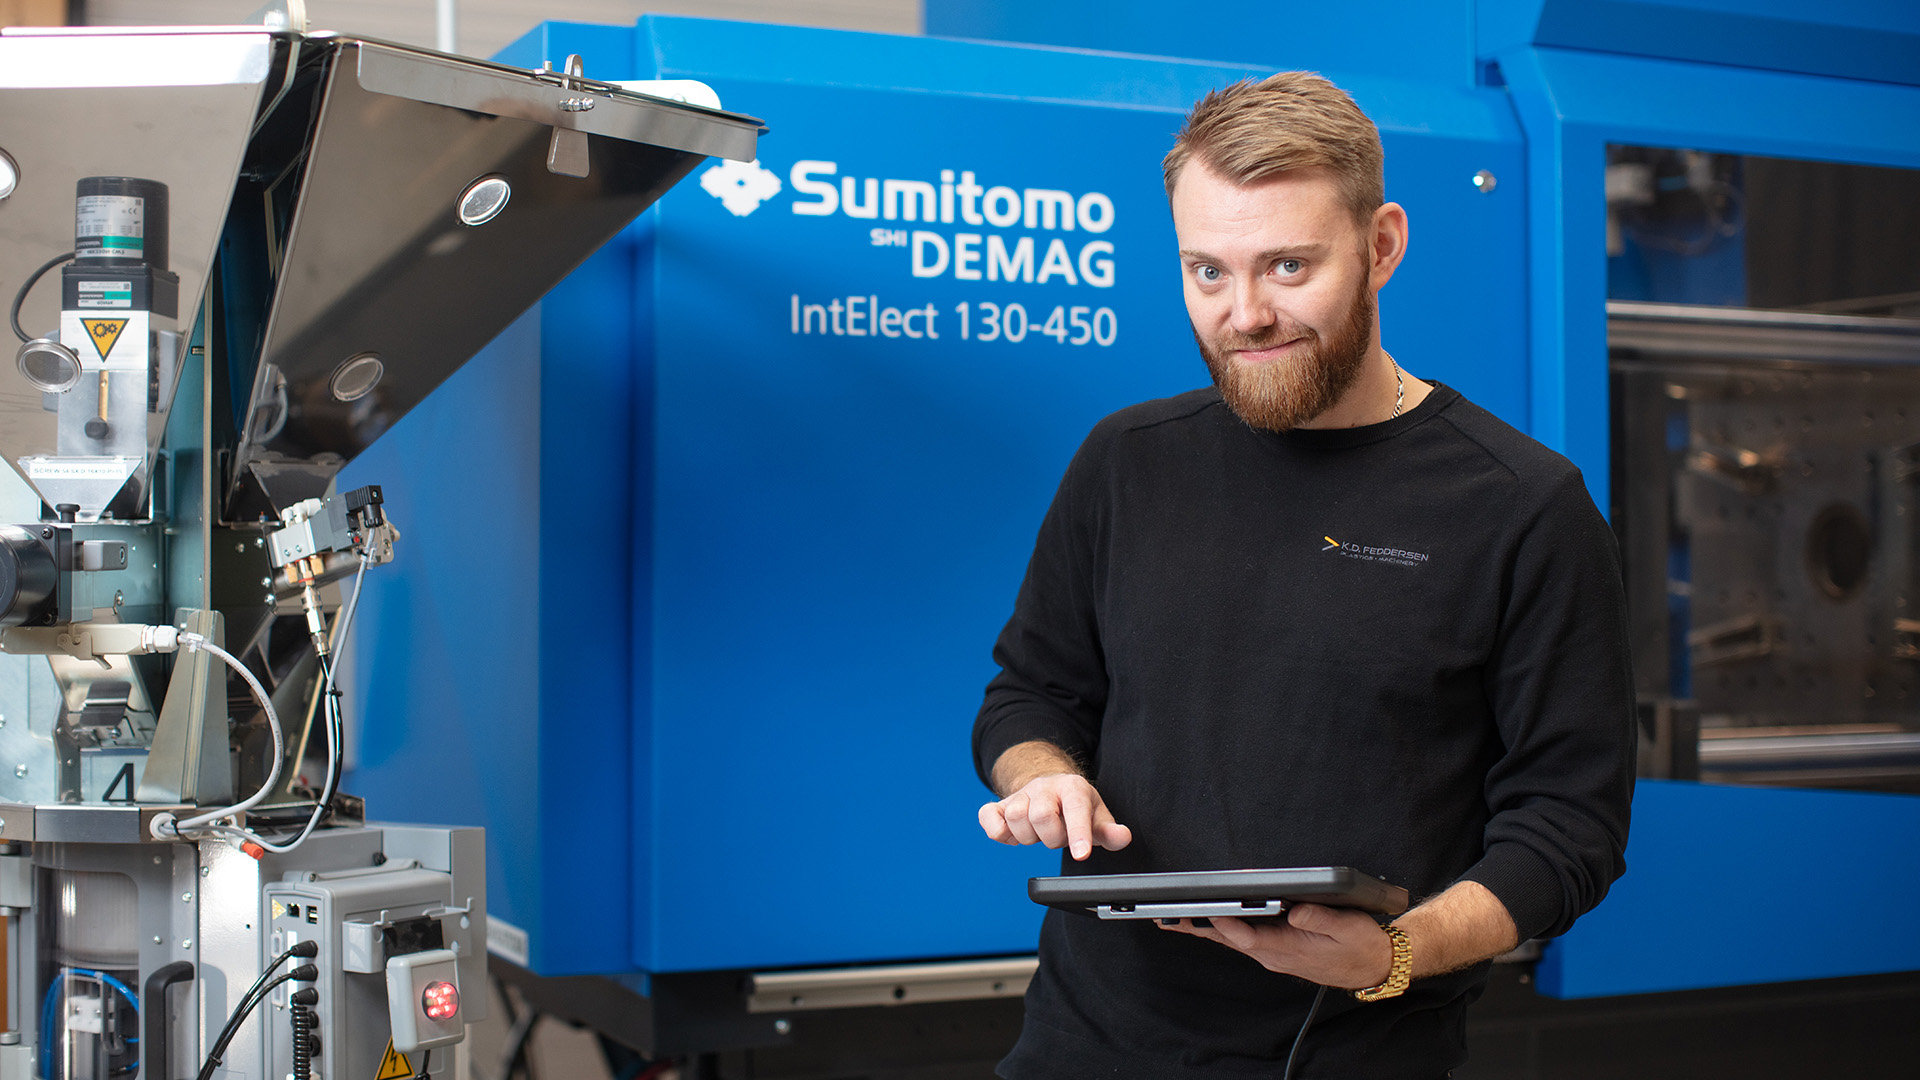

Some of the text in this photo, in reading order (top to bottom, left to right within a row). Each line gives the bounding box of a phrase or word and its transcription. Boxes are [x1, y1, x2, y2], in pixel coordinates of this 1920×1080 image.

[790, 160, 1115, 234] Sumitomo
[870, 228, 1115, 288] SHI DEMAG
[791, 294, 1117, 347] IntElect 130-450
[1341, 541, 1429, 562] K.D. FEDDERSEN
[102, 763, 135, 802] 4
